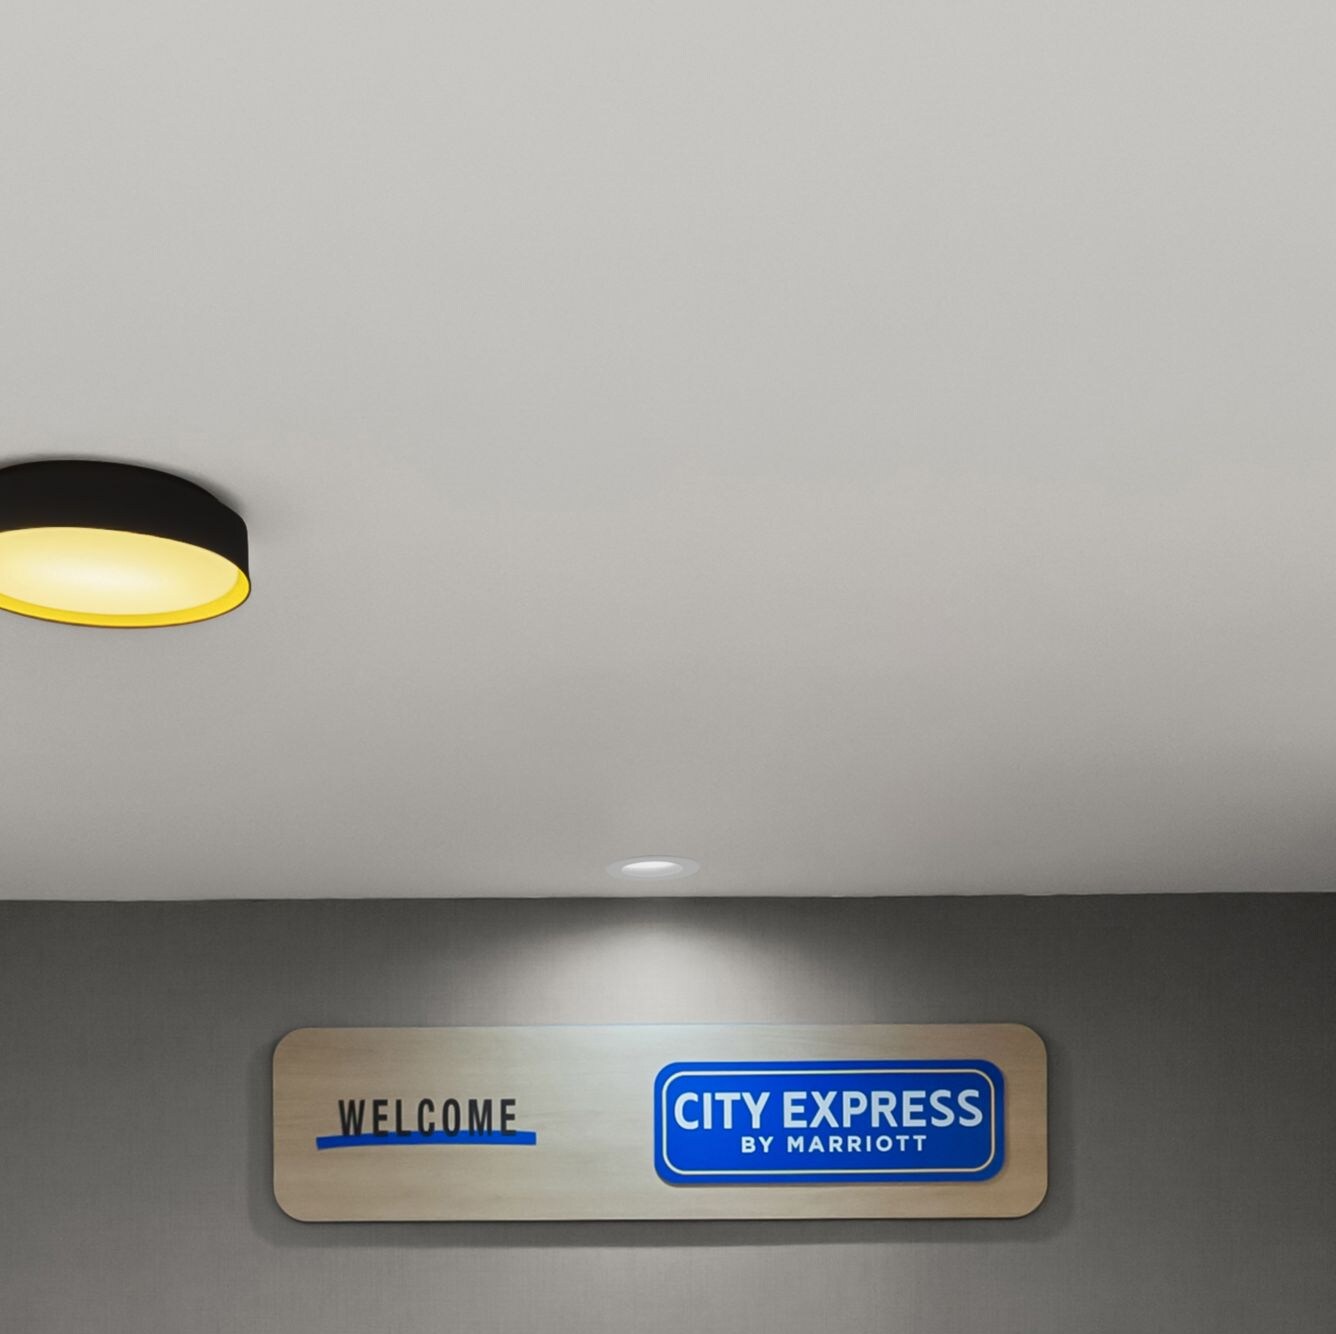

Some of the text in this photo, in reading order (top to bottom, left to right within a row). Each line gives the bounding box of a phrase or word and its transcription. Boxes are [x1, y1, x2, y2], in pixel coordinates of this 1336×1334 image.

[338, 1098, 517, 1137] WELCOME
[674, 1089, 984, 1130] CITY EXPRESS
[741, 1134, 928, 1153] BY MARRIOTT
